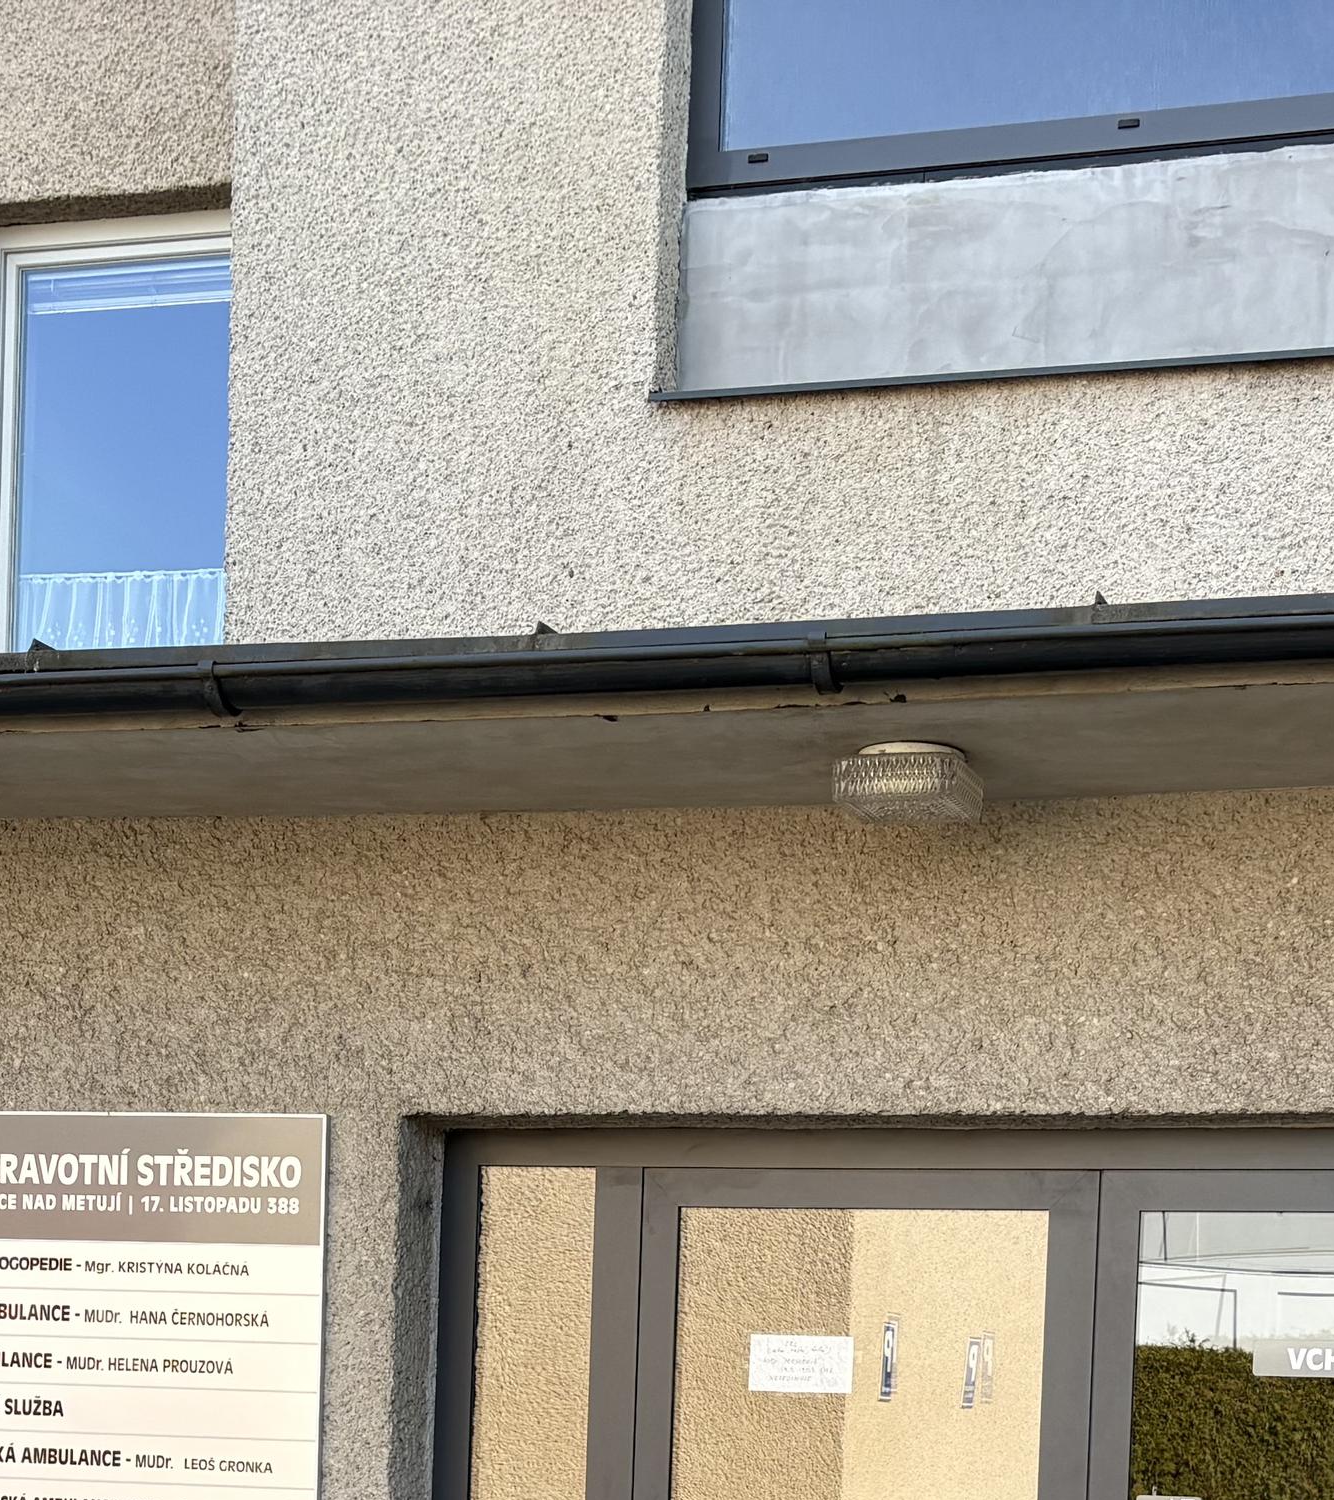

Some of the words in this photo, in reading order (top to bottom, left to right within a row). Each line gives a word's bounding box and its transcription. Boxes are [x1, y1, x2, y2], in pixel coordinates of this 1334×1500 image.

[137, 1148, 302, 1188] STŘEDISKO
[23, 1194, 57, 1210] NAD
[62, 1192, 122, 1212] METUJÍ
[141, 1196, 163, 1212] 17.
[170, 1196, 261, 1214] LISTOPADU
[267, 1197, 299, 1214] 388
[85, 1260, 114, 1274] Mgr.
[119, 1260, 183, 1274] KRISTÝNA
[187, 1261, 249, 1276] KOLÁČNÁ
[85, 1309, 121, 1324] MUDr.
[130, 1310, 167, 1325] HANA
[171, 1309, 269, 1328] ČERNOHORSKÁ
[67, 1356, 104, 1371] MUDr.
[108, 1358, 158, 1372] HELENA
[163, 1358, 233, 1374] PROUZOVÁ
[4, 1396, 64, 1417] SLUŽBA
[21, 1447, 121, 1467] AMBULANCE
[135, 1454, 173, 1470] MUDr.
[185, 1458, 215, 1470] LEOŠ
[219, 1460, 273, 1474] GRONKA
